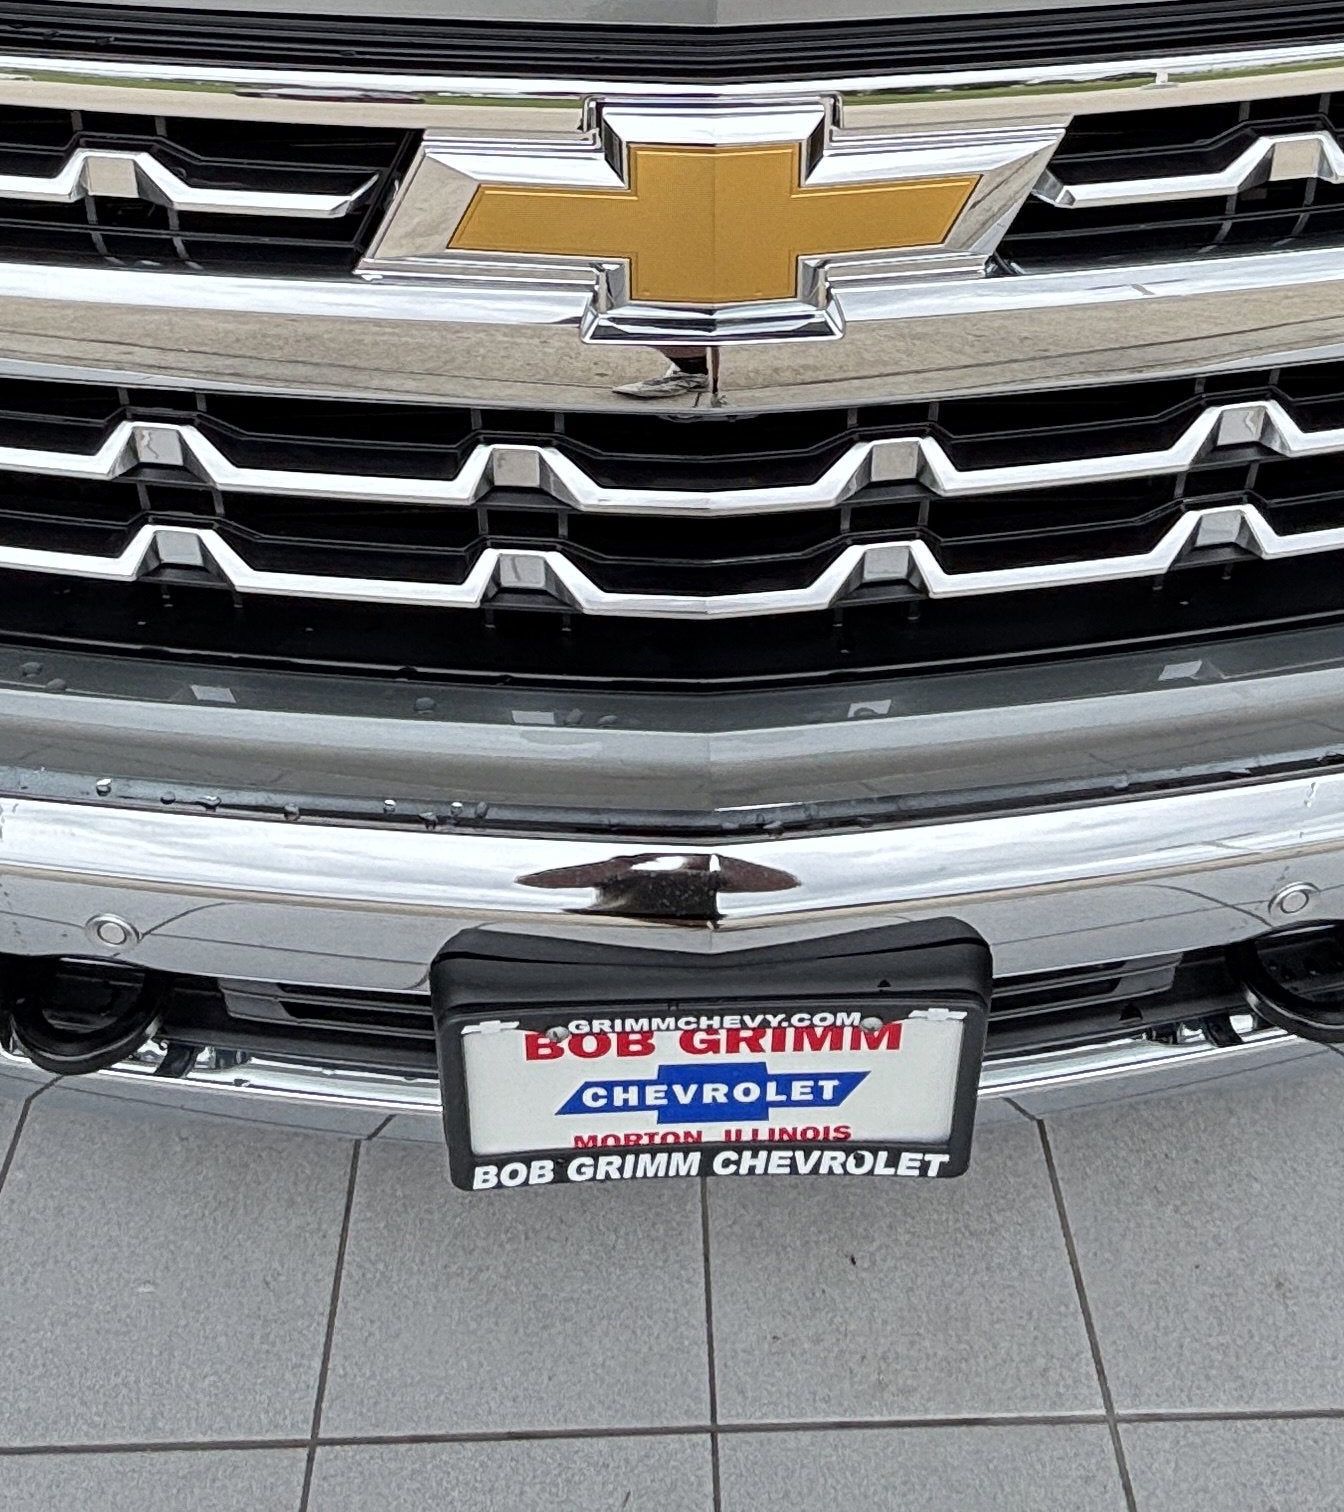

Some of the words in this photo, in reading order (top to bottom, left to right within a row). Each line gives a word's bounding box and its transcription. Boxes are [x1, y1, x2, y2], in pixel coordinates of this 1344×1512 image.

[567, 1012, 862, 1034] GRIMMCHEVY.COM
[525, 1032, 656, 1061] BOB
[679, 1023, 903, 1055] GRIMM
[582, 1079, 841, 1108] CHEVROLET
[573, 1130, 703, 1149] MORTON
[472, 1159, 555, 1190] BOB
[567, 1151, 702, 1182] GRIMM
[712, 1149, 951, 1177] CHEVROLET
